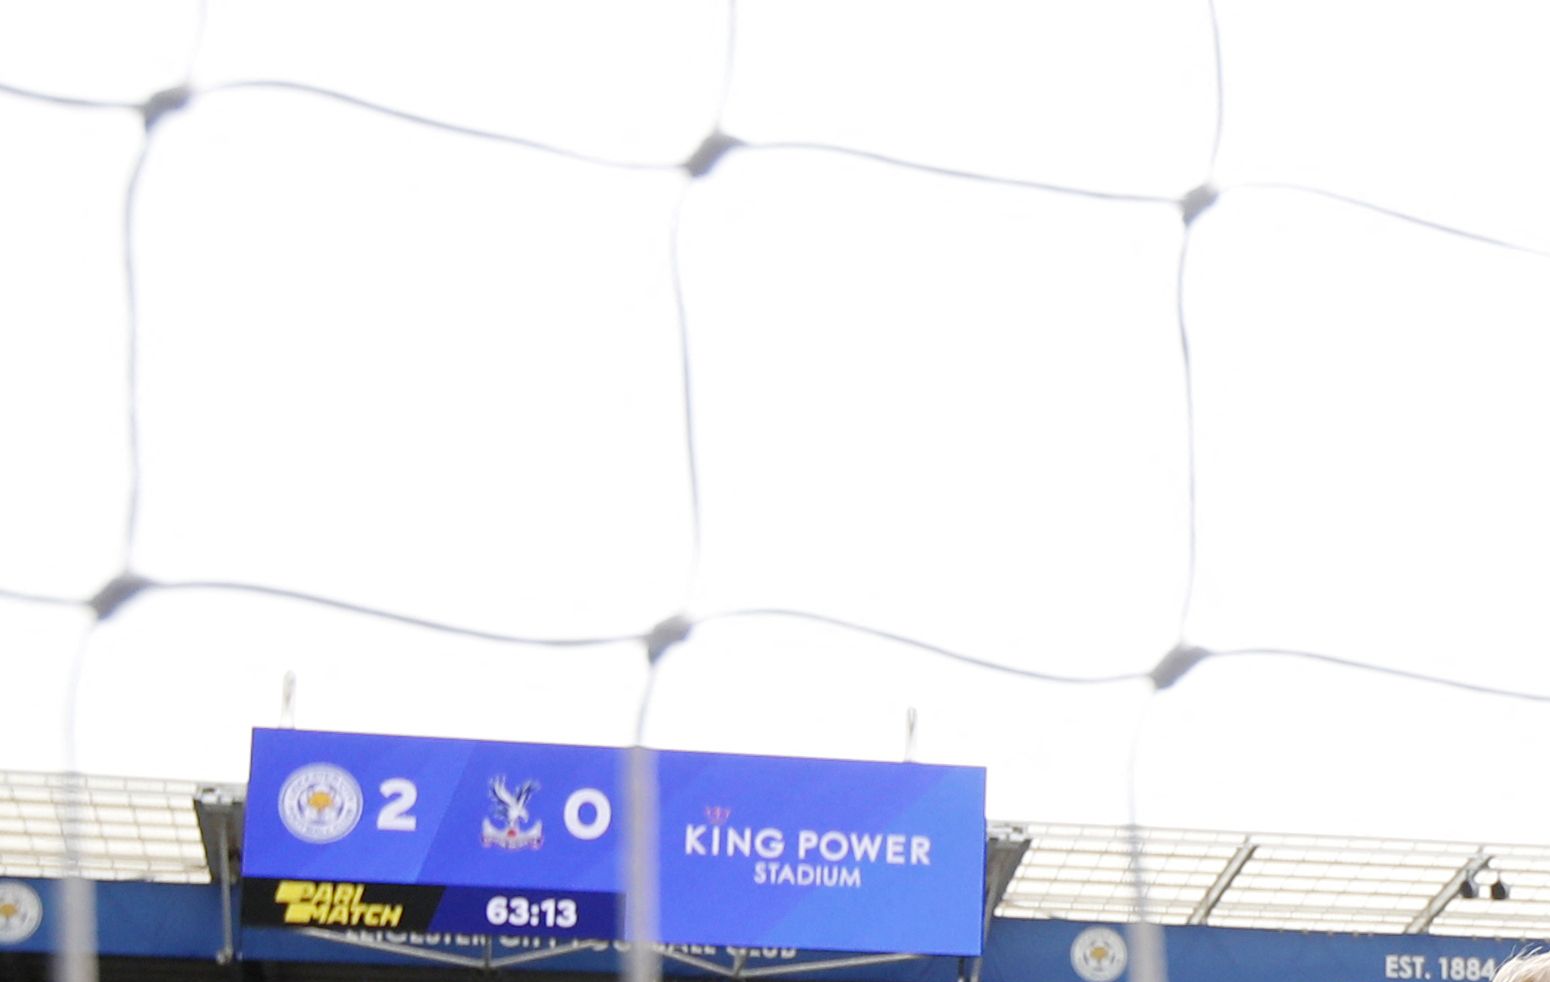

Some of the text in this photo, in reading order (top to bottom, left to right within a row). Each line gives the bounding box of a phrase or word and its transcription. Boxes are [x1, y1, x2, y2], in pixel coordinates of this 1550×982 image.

[377, 778, 418, 831] 2
[563, 788, 612, 840] 0
[685, 824, 932, 865] KING POWER
[753, 862, 862, 887] STADIUM
[486, 896, 578, 928] 63:13
[1385, 955, 1496, 982] EST. 1884
